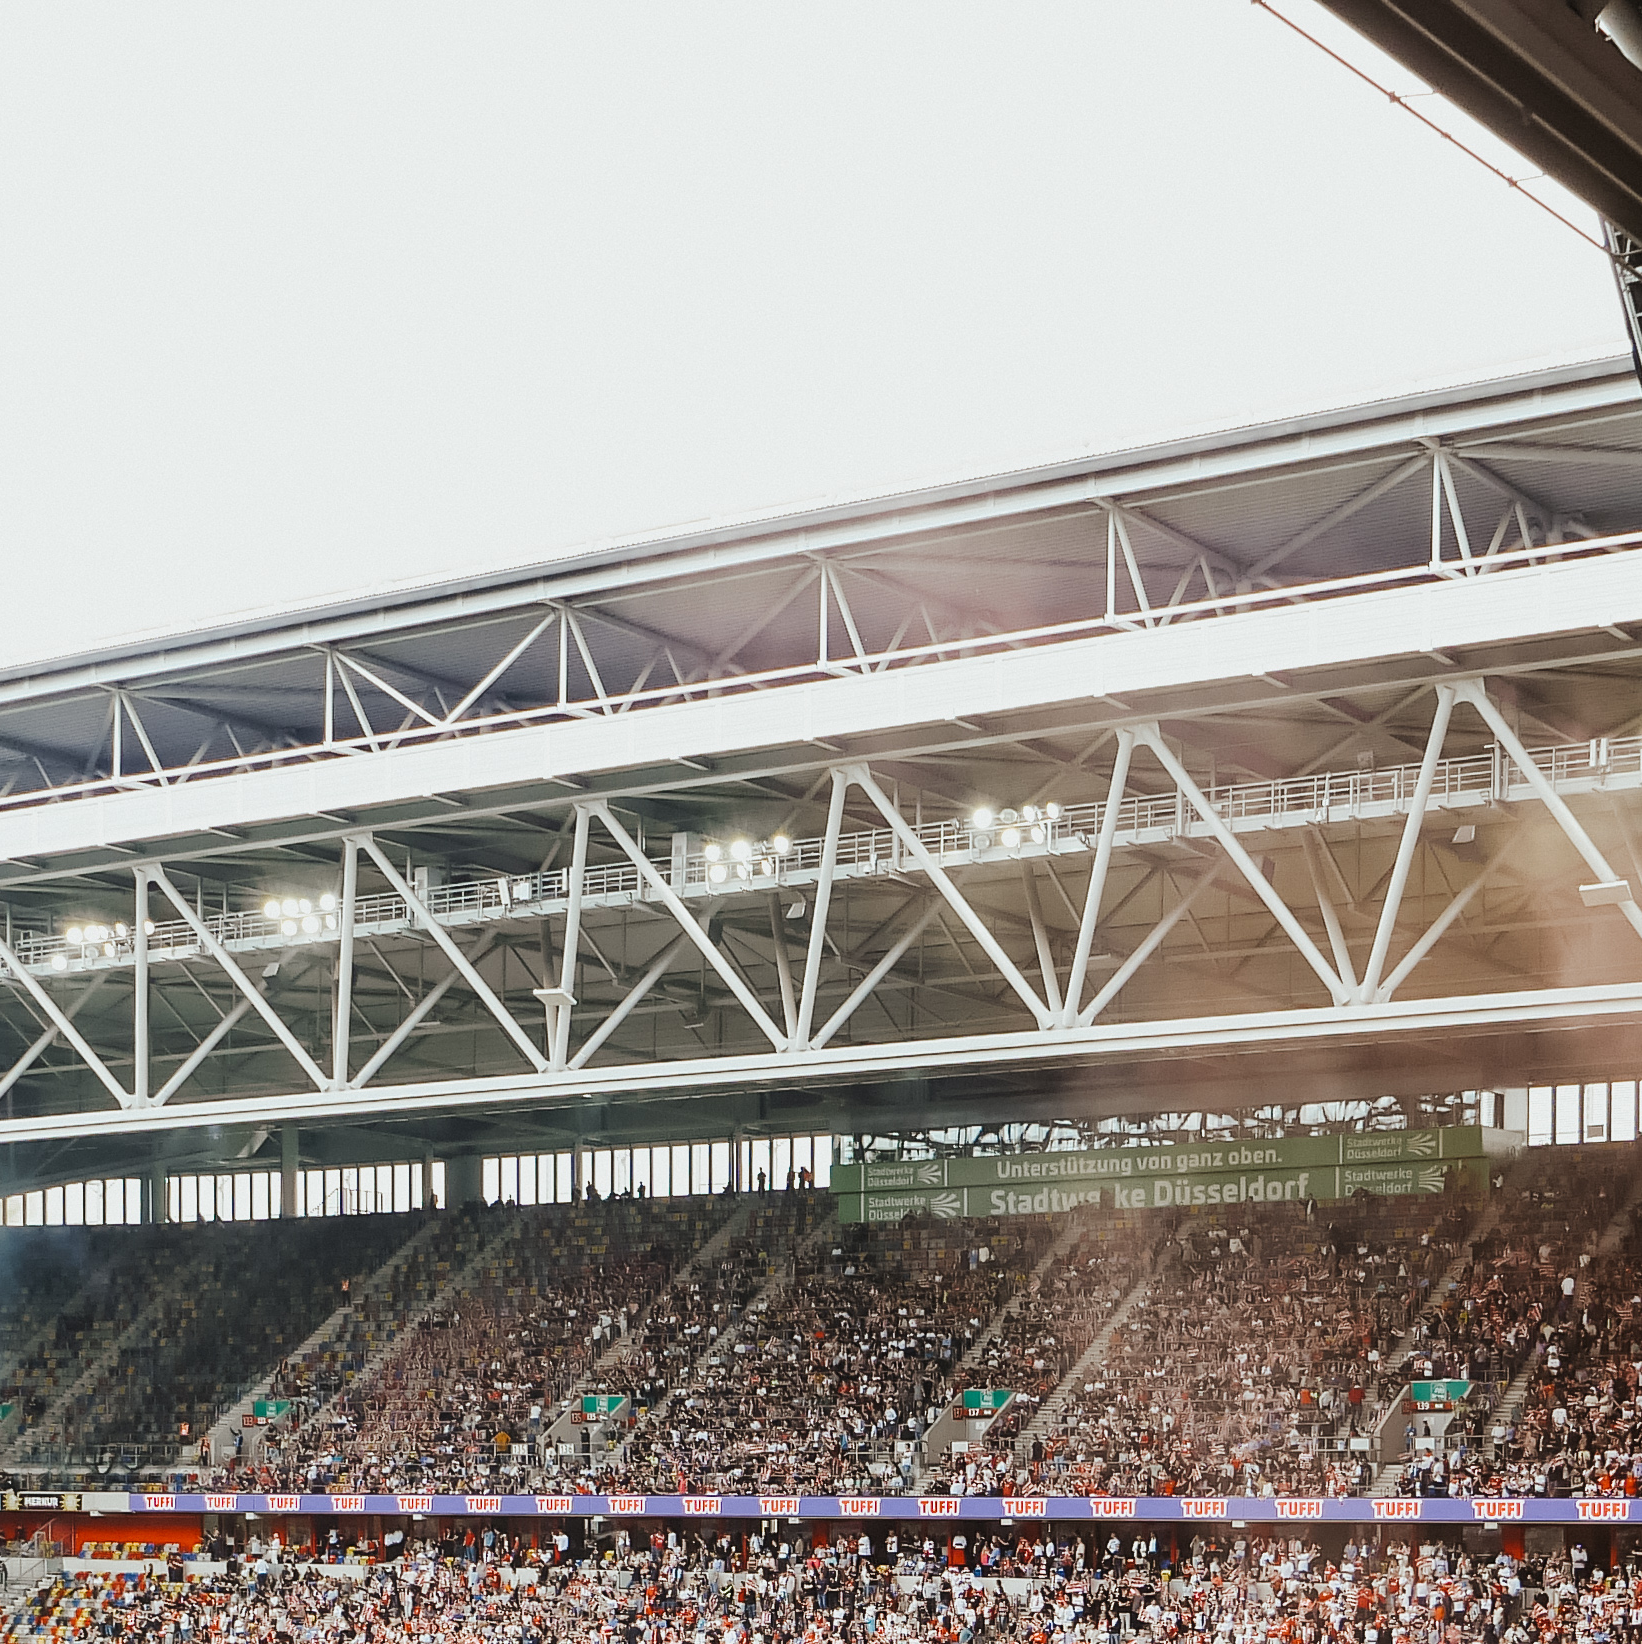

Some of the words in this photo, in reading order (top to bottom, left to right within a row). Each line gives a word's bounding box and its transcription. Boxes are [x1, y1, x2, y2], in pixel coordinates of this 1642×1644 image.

[1346, 1135, 1403, 1149] Stadtwerke
[1346, 1145, 1403, 1160] Düsseldorf
[867, 1165, 914, 1178] Stadtwerke
[996, 1155, 1132, 1180] Unterstützung
[1136, 1154, 1172, 1171] von
[1177, 1149, 1223, 1173] ganz
[1227, 1147, 1283, 1167] oben.
[867, 1175, 915, 1188] Düsseldorf
[1344, 1167, 1413, 1182] Stadtwerke
[1154, 1172, 1310, 1206] Düsseldorf
[868, 1194, 927, 1208] Stadtwerke
[24, 1496, 60, 1508] MERKUR
[144, 1494, 177, 1511] TUFFI
[205, 1494, 238, 1511] TUFFI
[267, 1495, 302, 1511] TUFFI
[331, 1495, 366, 1512] TUFFI
[396, 1495, 434, 1512] TUFFI
[465, 1496, 503, 1513] TUFFI
[535, 1496, 574, 1513] TUFFI
[607, 1496, 647, 1514] TUFFI
[683, 1497, 722, 1515] TUFFI
[759, 1497, 801, 1515] TUFFI
[839, 1497, 881, 1516] TUFFI
[918, 1497, 960, 1516] TUFFI
[1002, 1497, 1047, 1517] TUFFI
[1089, 1498, 1137, 1517] TUFFI
[1180, 1499, 1229, 1518] TUFFI
[1273, 1499, 1324, 1518] TUFFI
[1370, 1499, 1423, 1519] TUFFI
[1471, 1499, 1524, 1520] TUFFI
[1575, 1499, 1630, 1520] TUFFI
